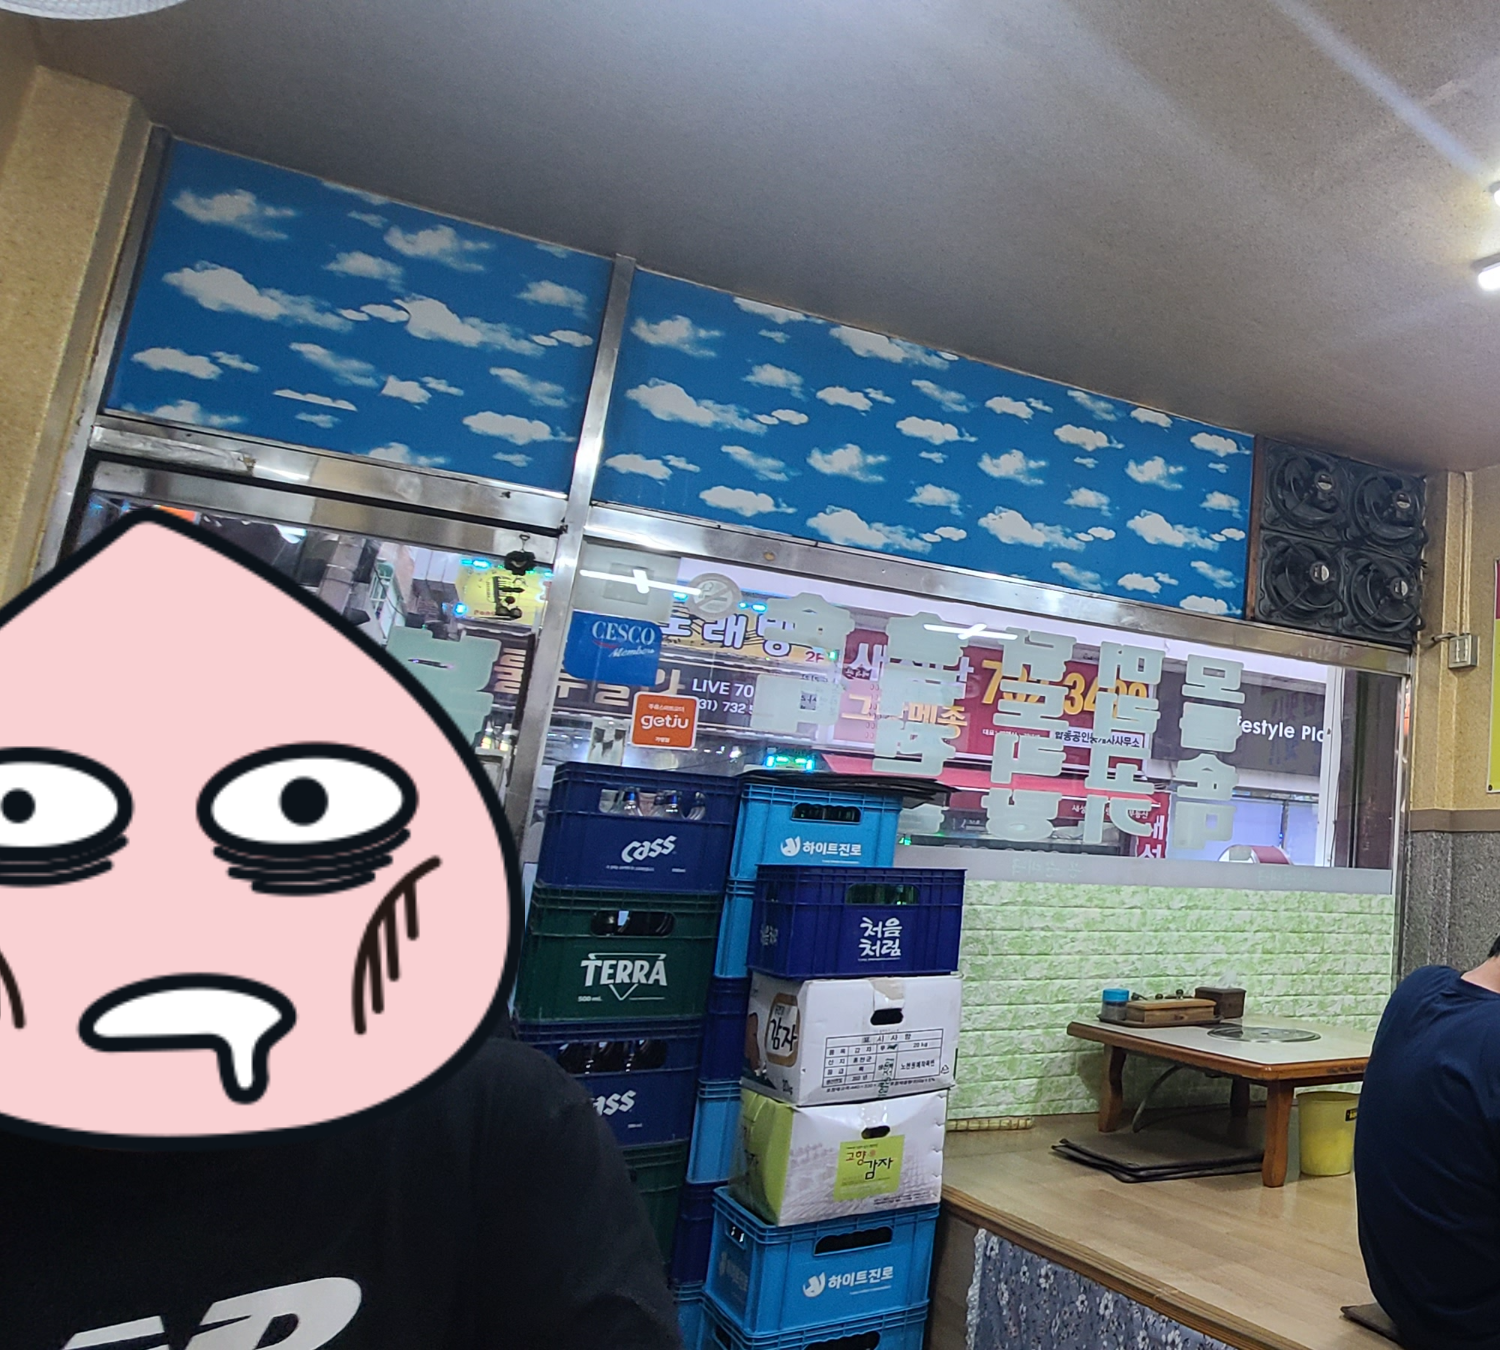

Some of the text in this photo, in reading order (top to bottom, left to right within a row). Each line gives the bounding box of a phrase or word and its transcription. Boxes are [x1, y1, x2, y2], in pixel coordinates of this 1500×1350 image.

[592, 621, 656, 646] CESCO
[692, 679, 730, 695] LIVE
[698, 698, 718, 711] 31)
[723, 702, 745, 714] 732
[842, 694, 968, 739] 그메종
[640, 712, 689, 730] getju
[802, 841, 862, 857] 하이트진로
[859, 917, 903, 939] 처음
[858, 939, 902, 957] 처럼
[580, 959, 668, 987] TERRA
[770, 1017, 798, 1052] 감자
[590, 1090, 636, 1116] ass
[845, 1150, 867, 1166] 고향
[864, 1157, 894, 1180] 감자
[828, 1266, 893, 1289] 하이트진로
